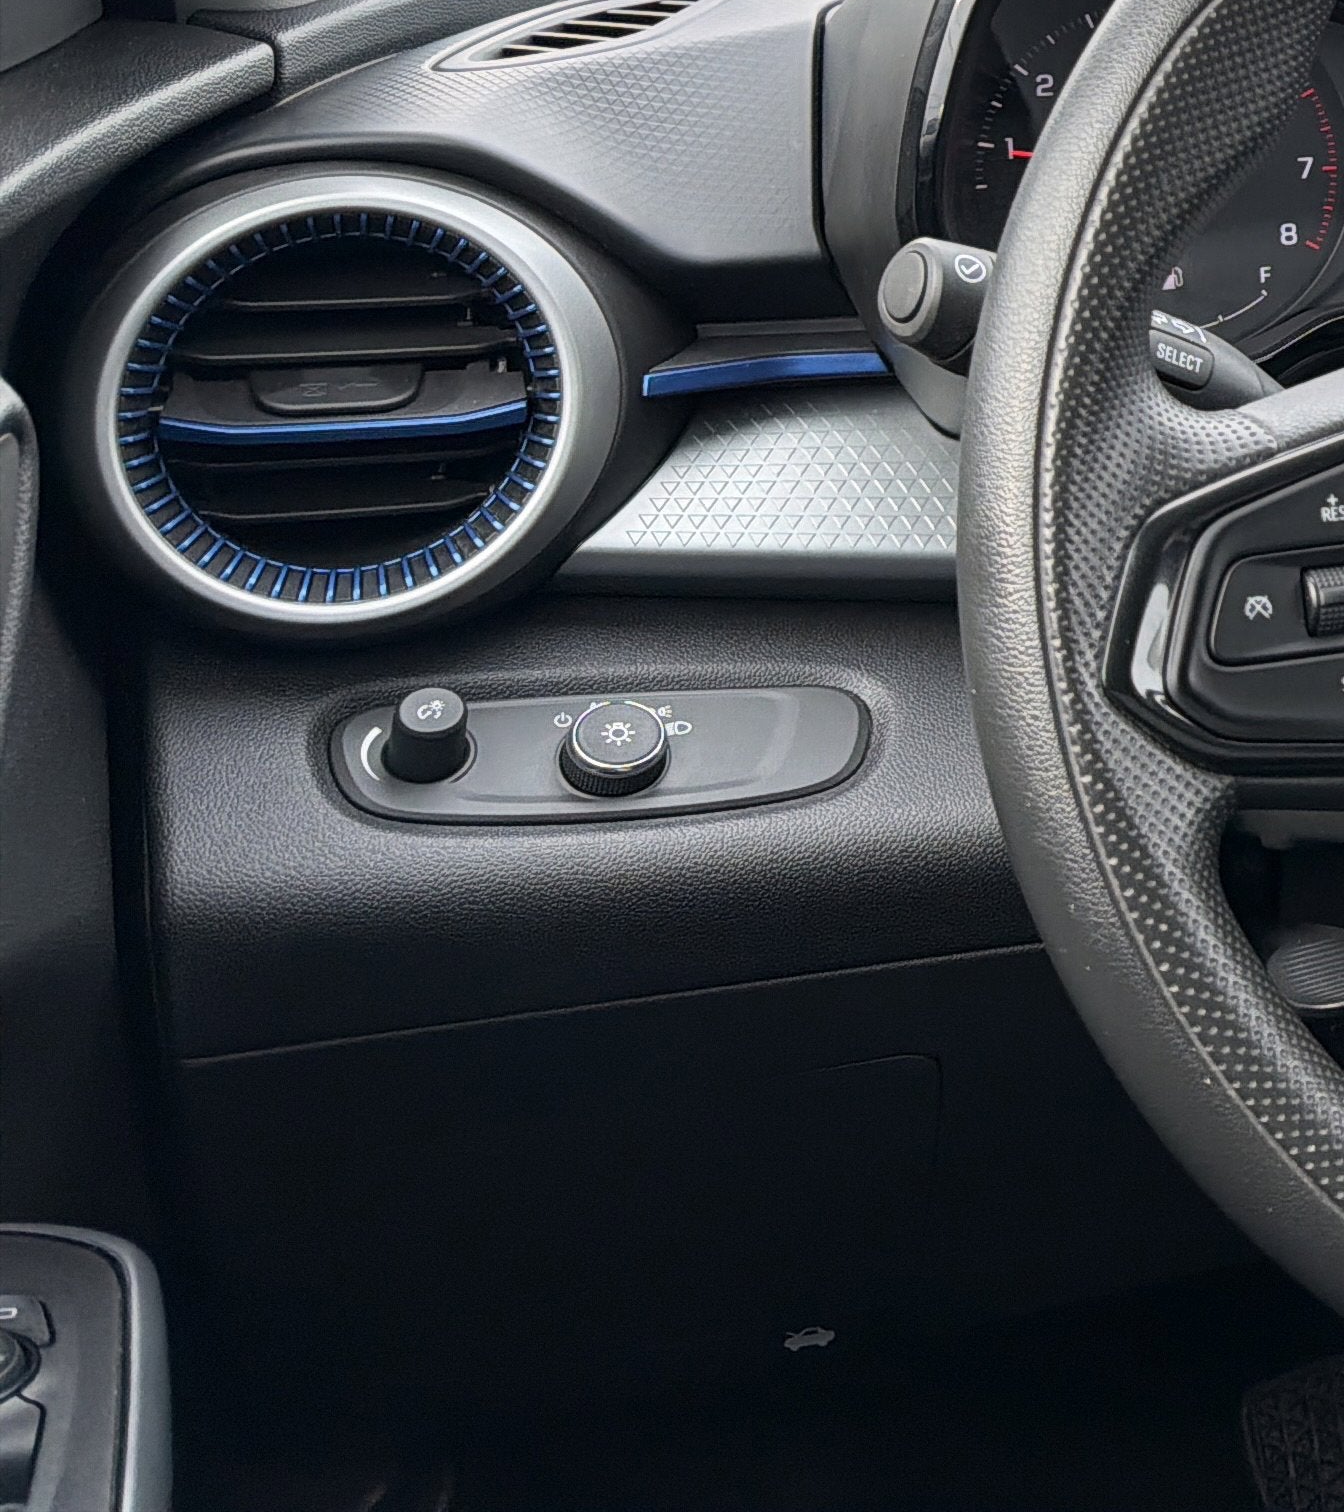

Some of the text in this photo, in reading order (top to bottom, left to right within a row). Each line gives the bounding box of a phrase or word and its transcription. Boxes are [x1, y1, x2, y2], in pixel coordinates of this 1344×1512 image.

[1036, 75, 1053, 97] 2
[1004, 137, 1015, 160] 1
[1297, 157, 1314, 179] 7
[1280, 223, 1298, 246] 8
[1260, 267, 1271, 283] F
[1156, 343, 1203, 373] SELECT
